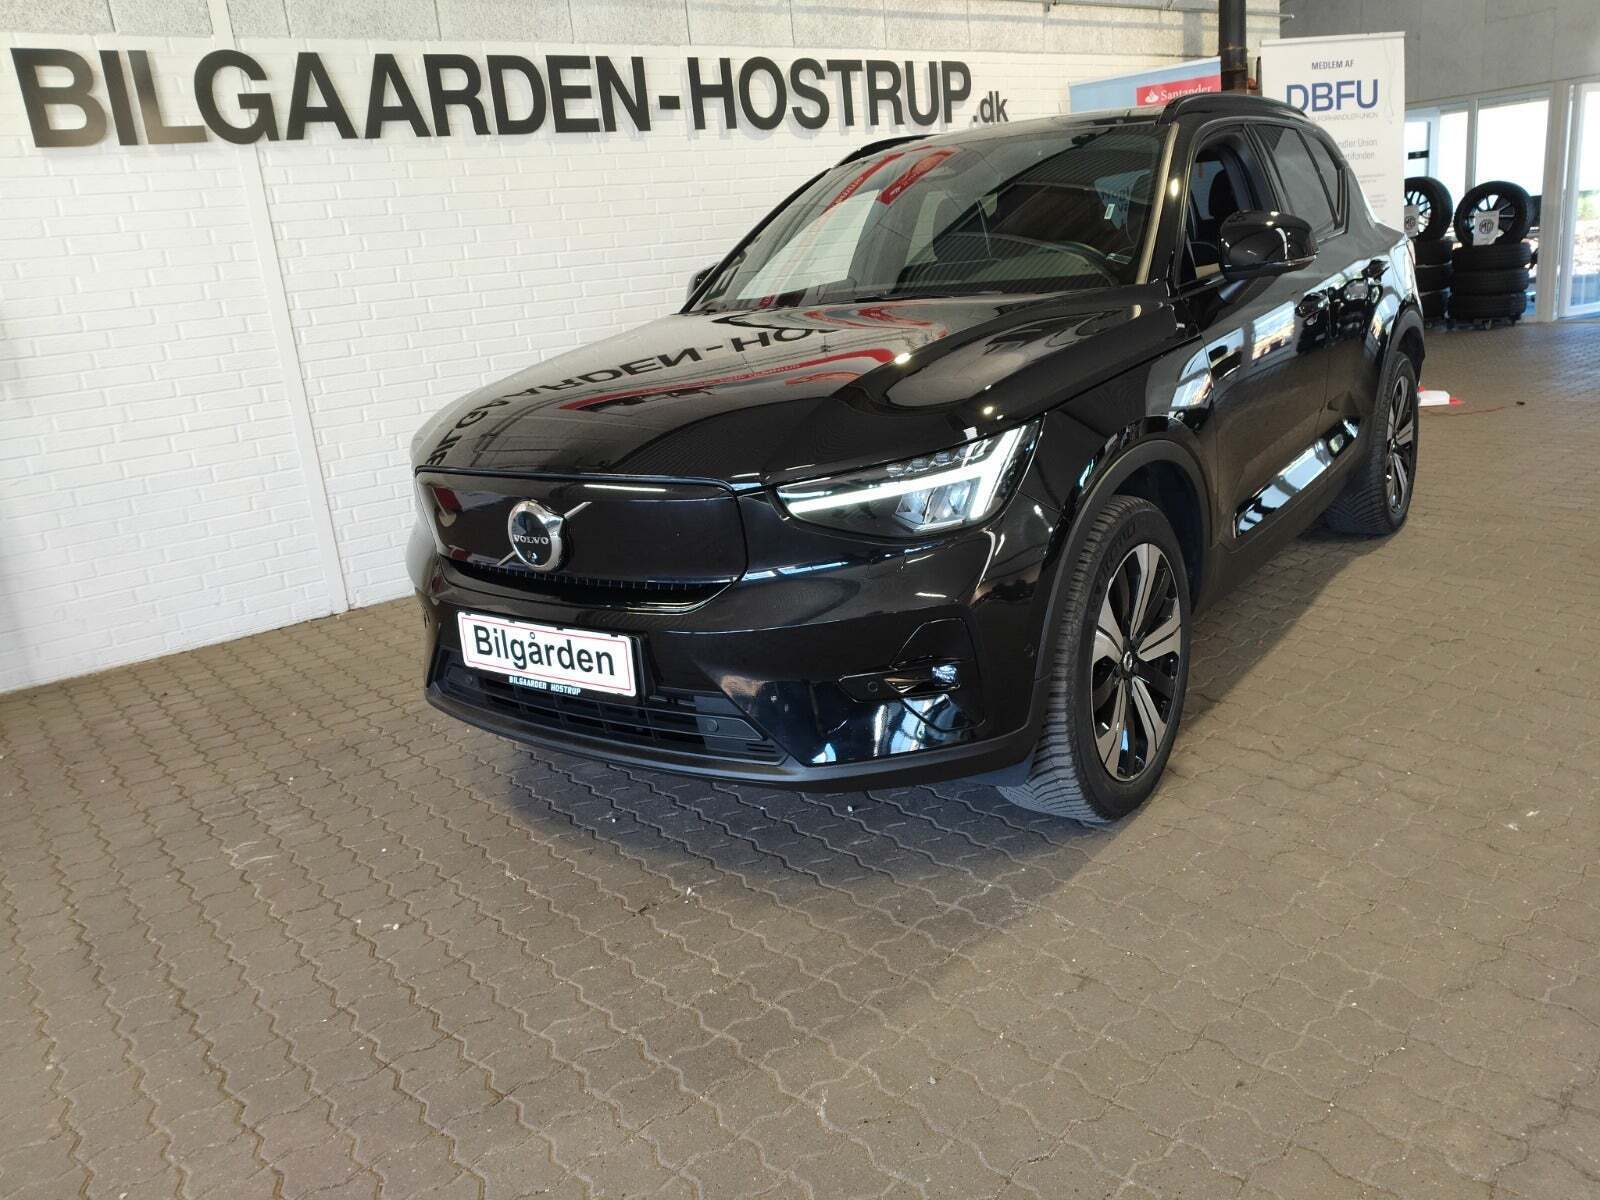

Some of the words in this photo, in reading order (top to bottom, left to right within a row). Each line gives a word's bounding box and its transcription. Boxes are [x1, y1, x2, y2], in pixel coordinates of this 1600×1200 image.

[1311, 60, 1343, 70] MEDLEM
[1345, 59, 1355, 68] AF
[1160, 83, 1212, 102] Santander
[1286, 79, 1378, 112] DBFU
[512, 534, 549, 545] VOLVO
[473, 624, 615, 676] Bilgården
[508, 676, 547, 690] BILGAARDEN
[550, 683, 581, 696] HOSTRUP
